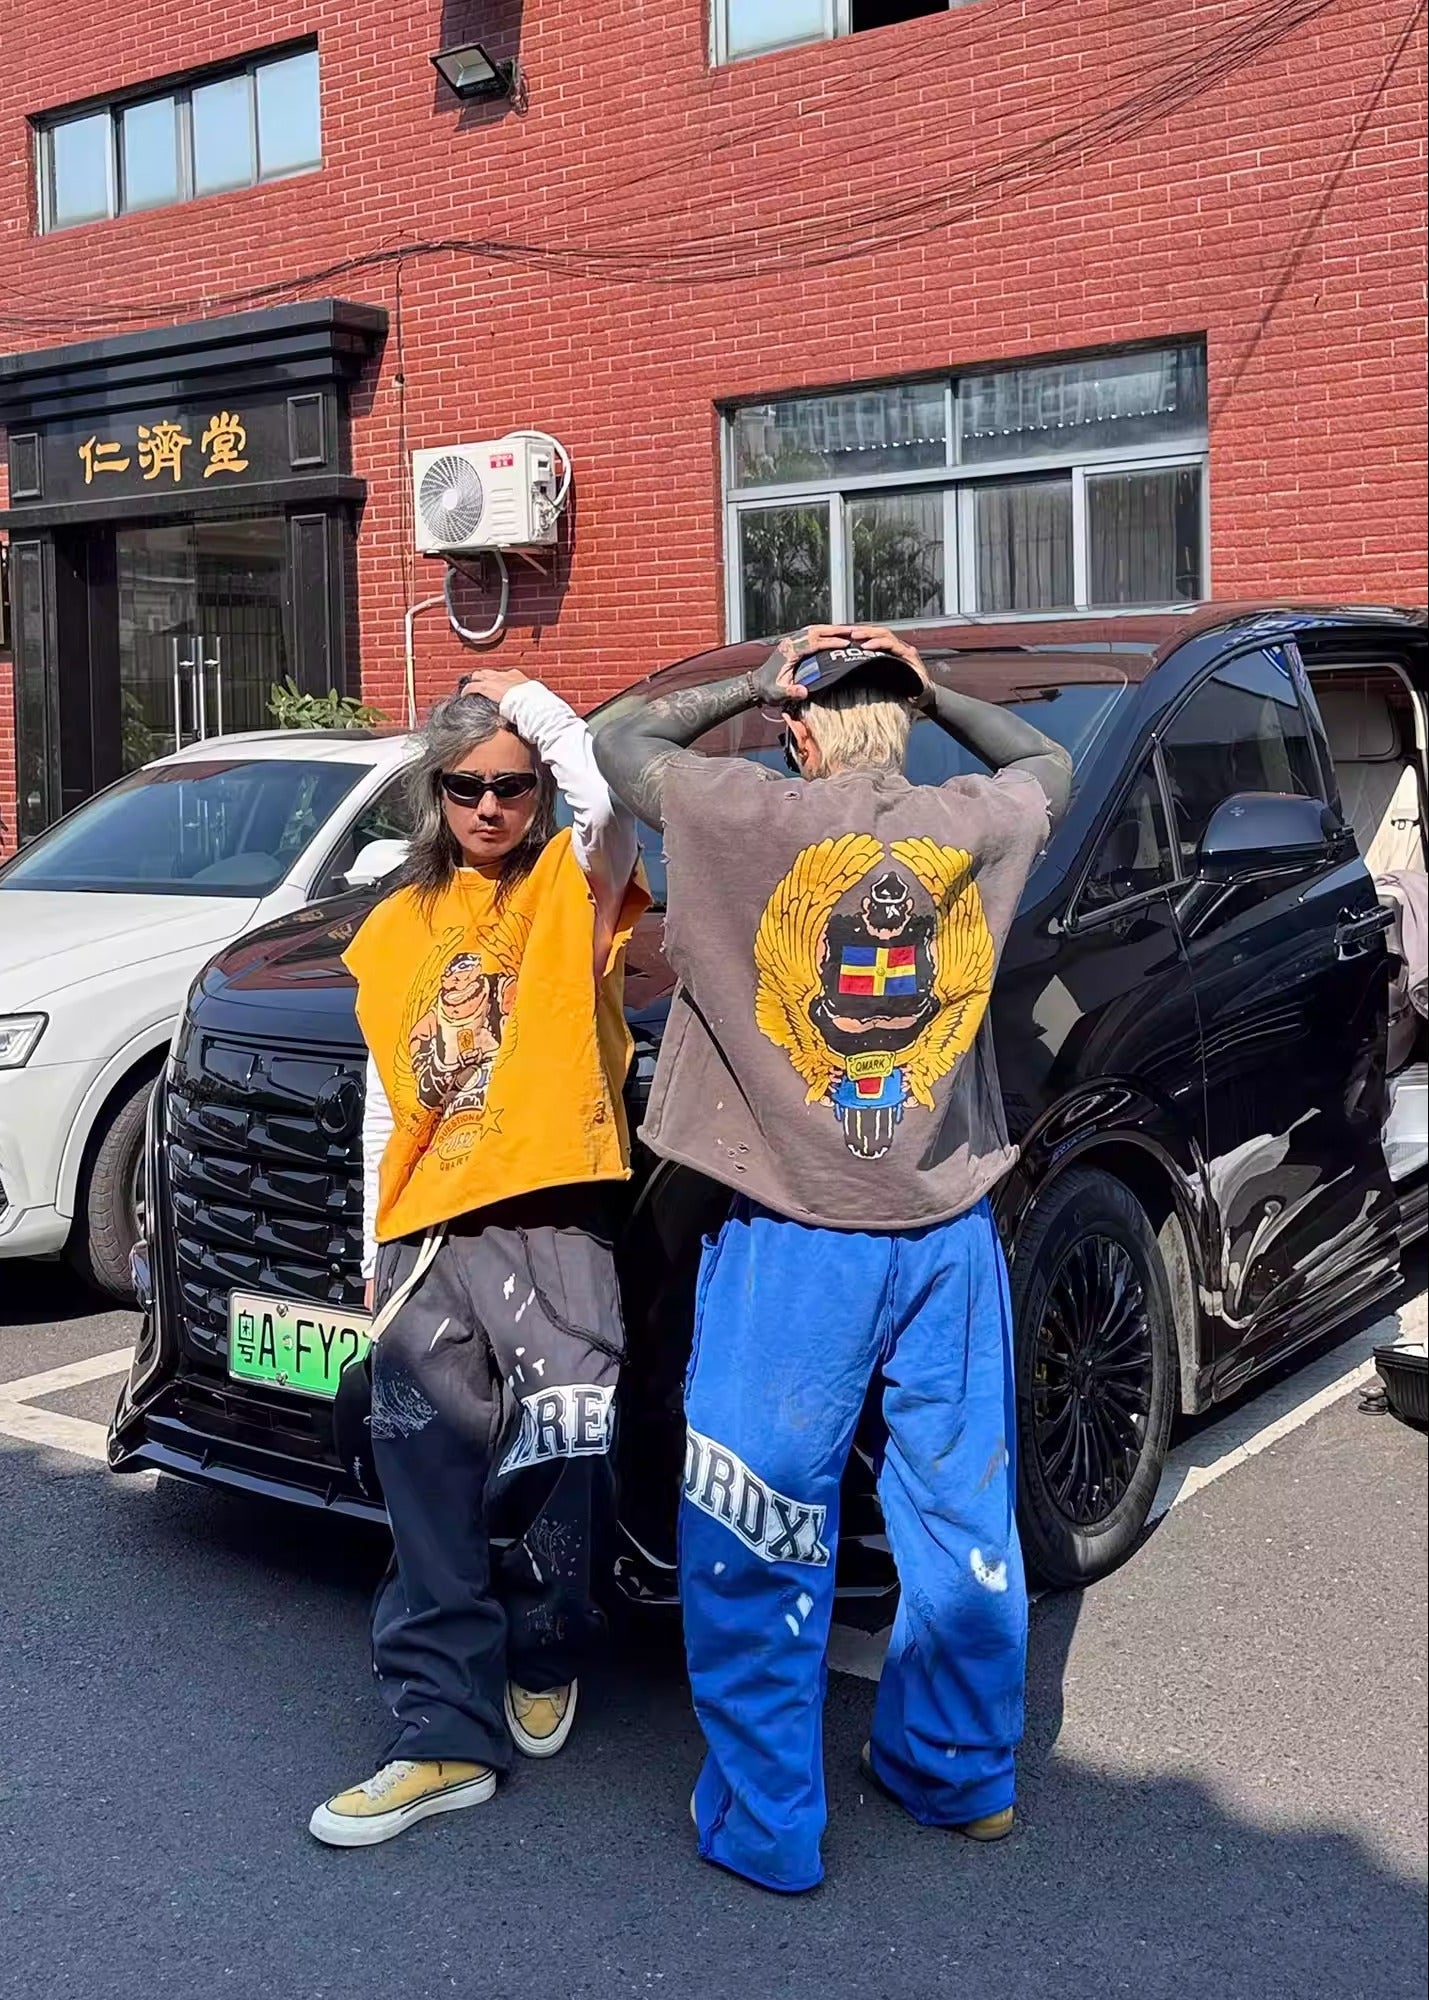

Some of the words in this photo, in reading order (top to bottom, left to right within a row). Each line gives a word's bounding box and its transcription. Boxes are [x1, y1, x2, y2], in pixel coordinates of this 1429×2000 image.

[78, 410, 249, 484] 仁濟堂
[295, 1319, 369, 1380] FY2
